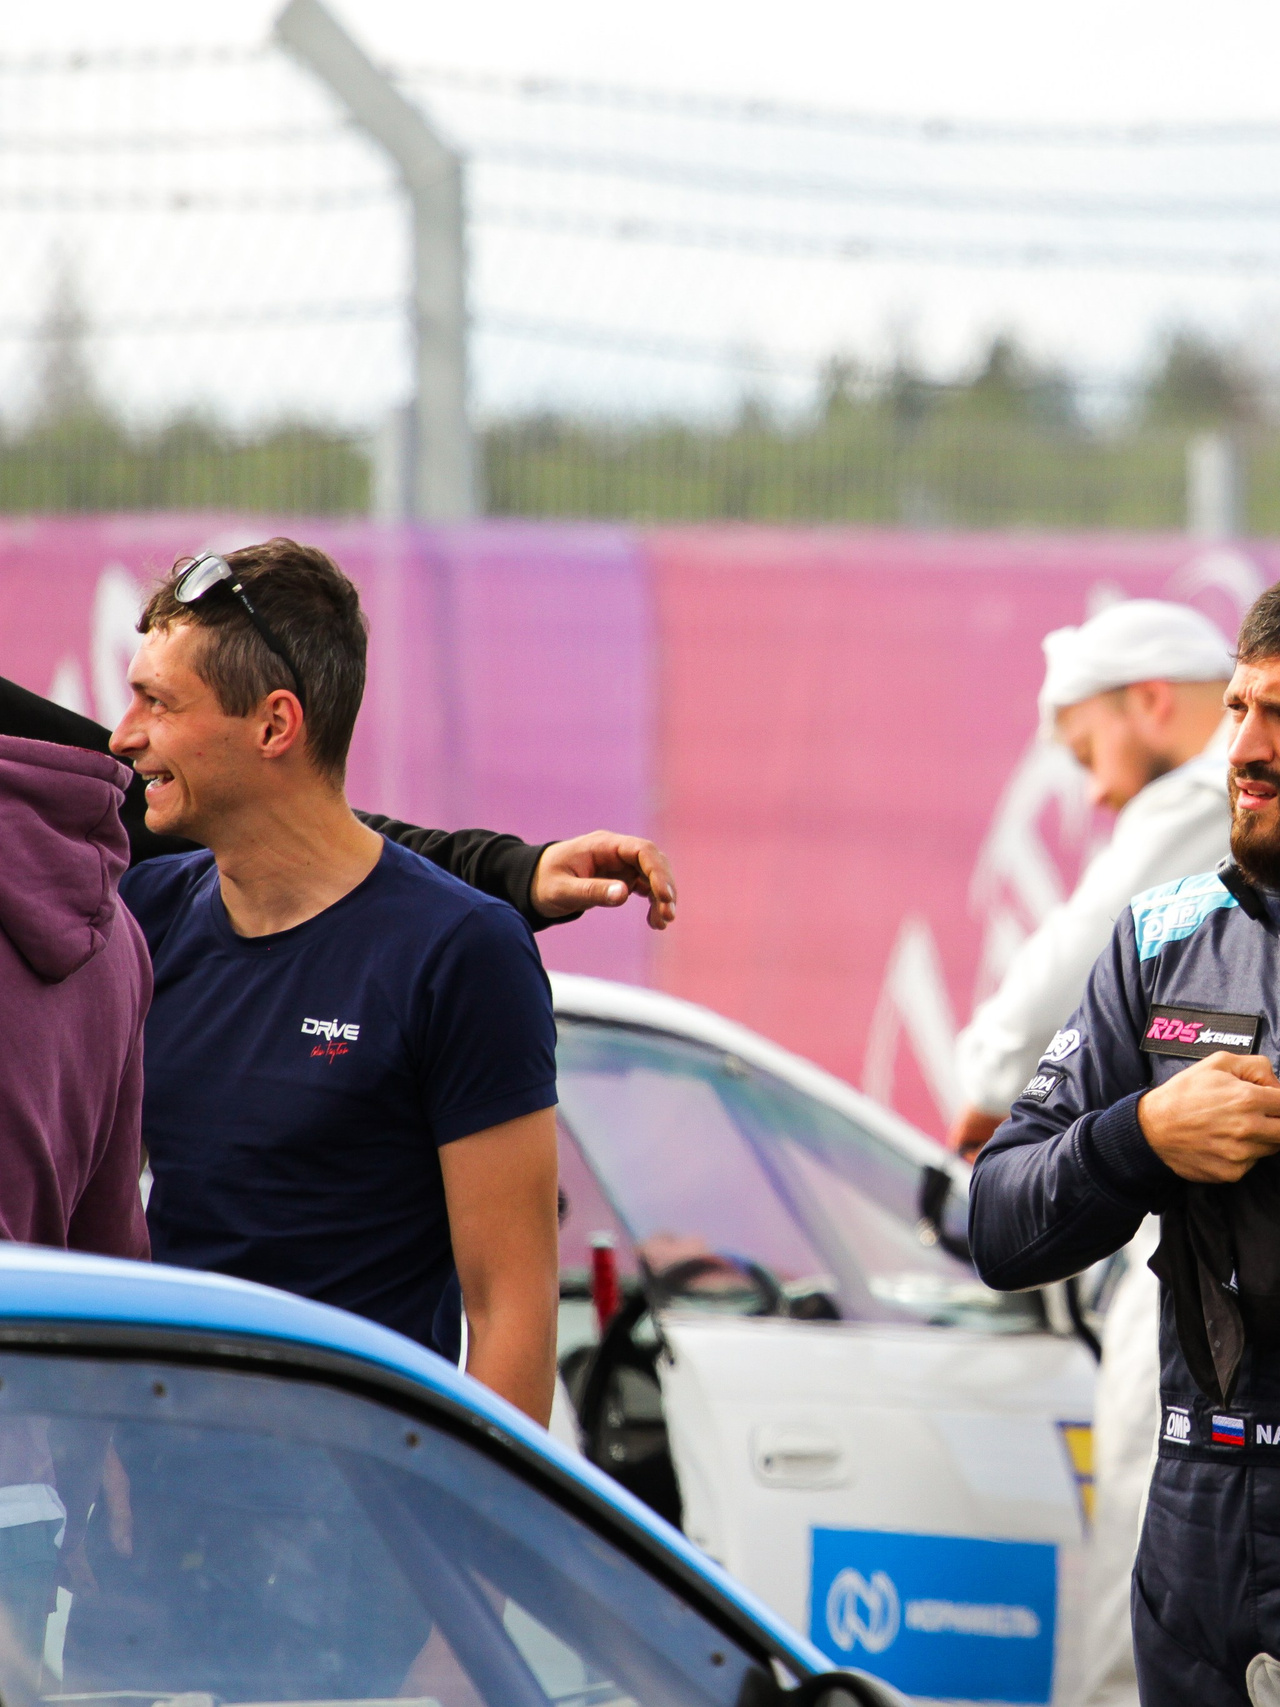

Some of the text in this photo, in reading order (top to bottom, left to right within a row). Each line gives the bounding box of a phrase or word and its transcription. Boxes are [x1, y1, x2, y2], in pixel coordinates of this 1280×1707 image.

[1146, 1017, 1253, 1047] RDS EUROPE
[1166, 1412, 1191, 1439] OMP
